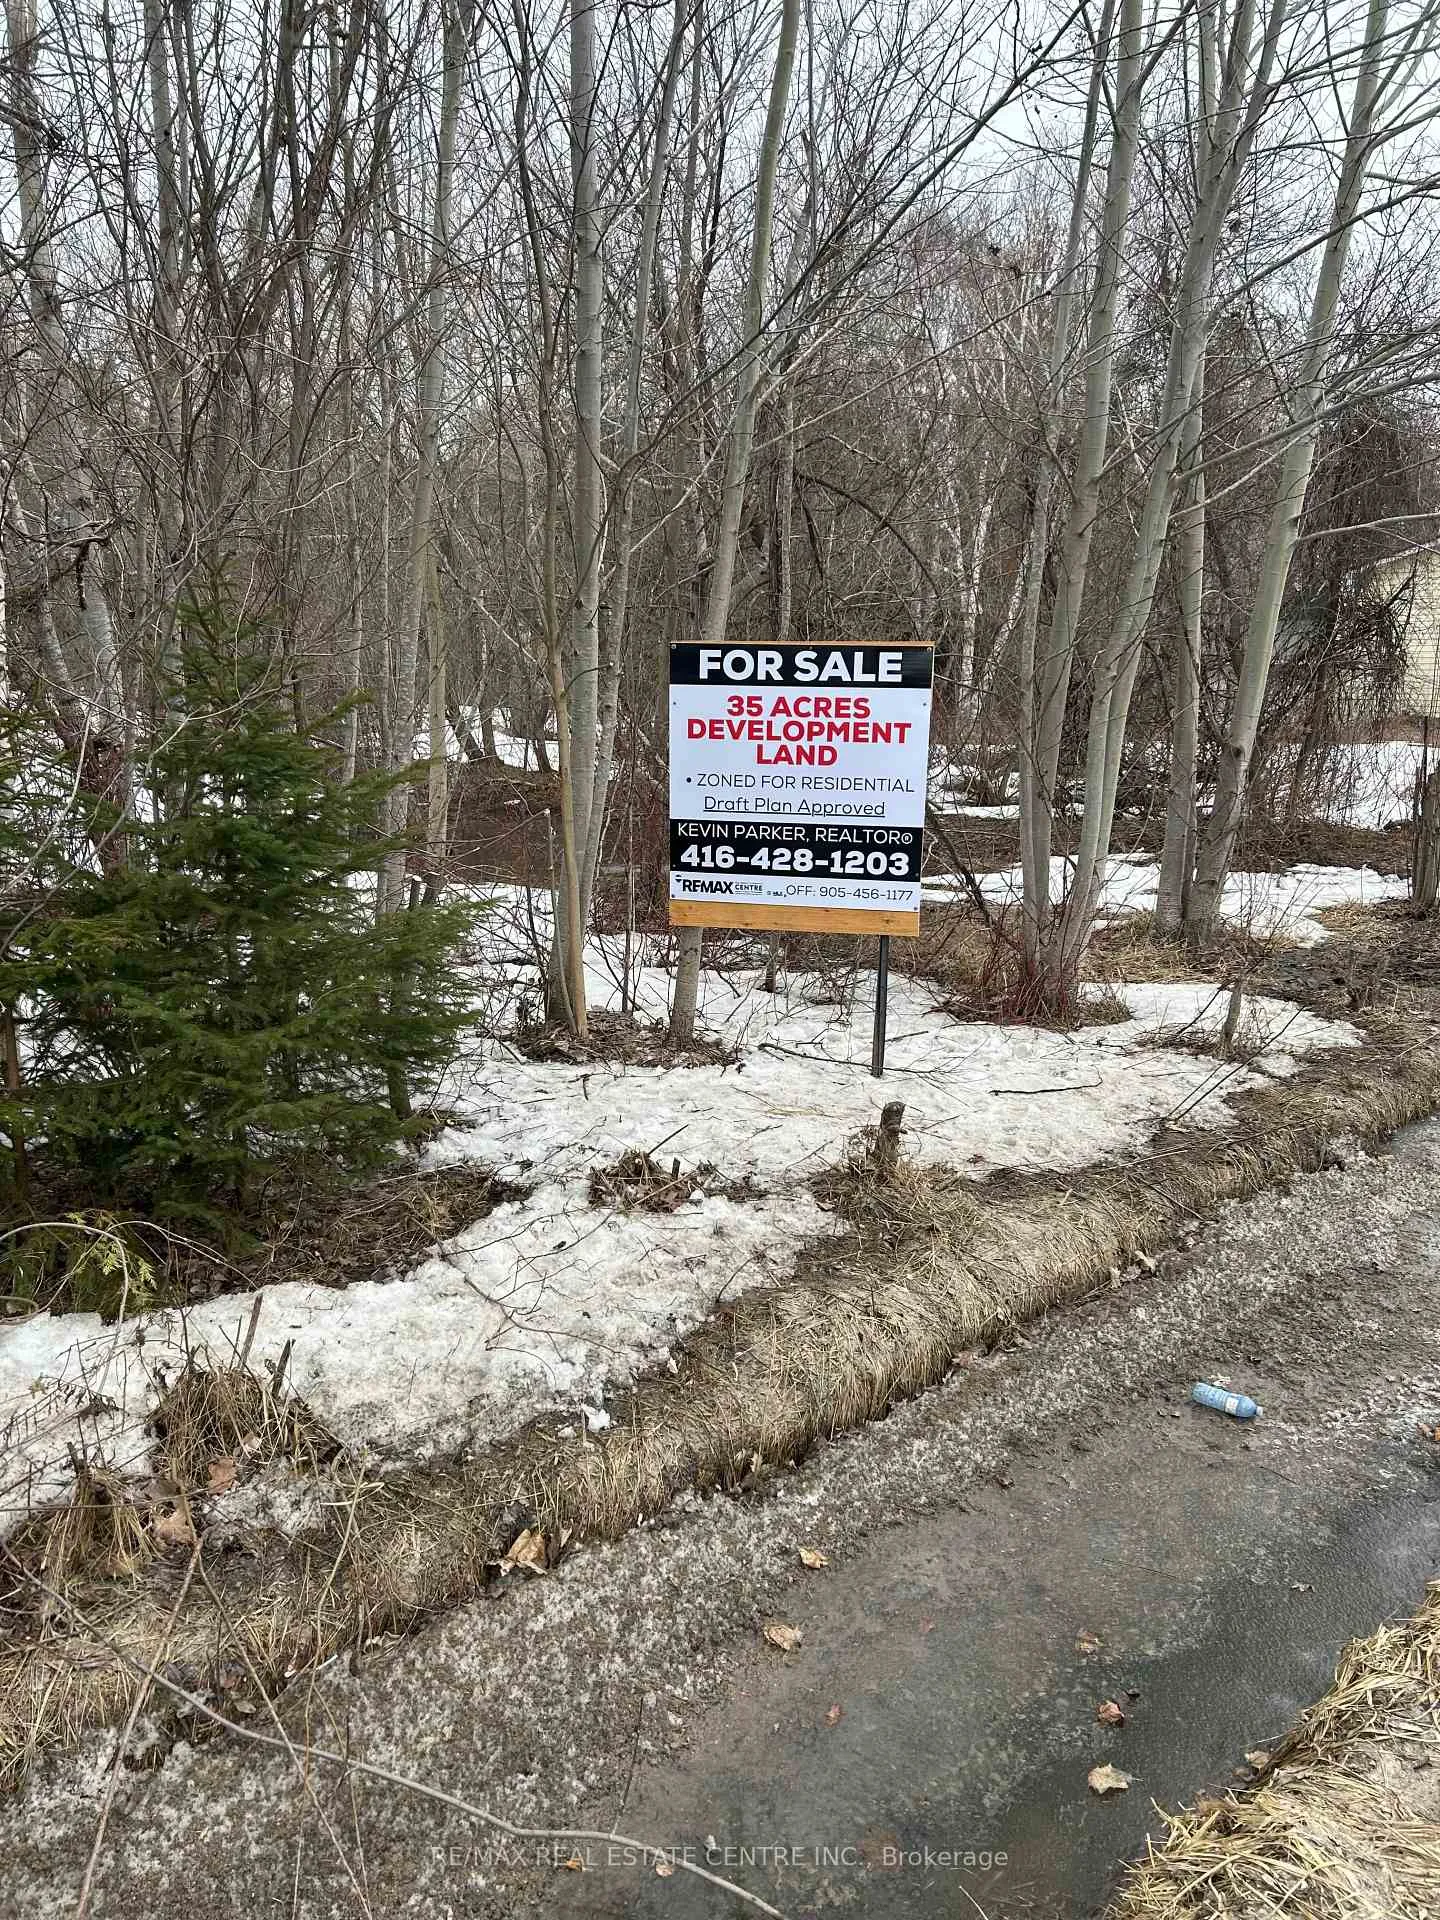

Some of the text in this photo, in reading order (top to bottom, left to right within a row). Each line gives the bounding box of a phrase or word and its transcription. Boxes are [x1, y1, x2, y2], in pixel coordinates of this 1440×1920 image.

[699, 649, 903, 683] FOR SALE
[727, 695, 871, 719] 35 ACRES
[687, 719, 911, 743] DEVELOPMENT
[756, 744, 838, 766] LAND
[697, 773, 915, 793] ZONED FOR RESIDENTIAL
[703, 796, 886, 818] Draft Plan Approved
[677, 823, 729, 838] KEVIN
[734, 825, 810, 843] PARKER,
[680, 844, 909, 876] 416-428-1203
[786, 884, 817, 898] OFF:
[819, 886, 914, 902] 905-456-1177
